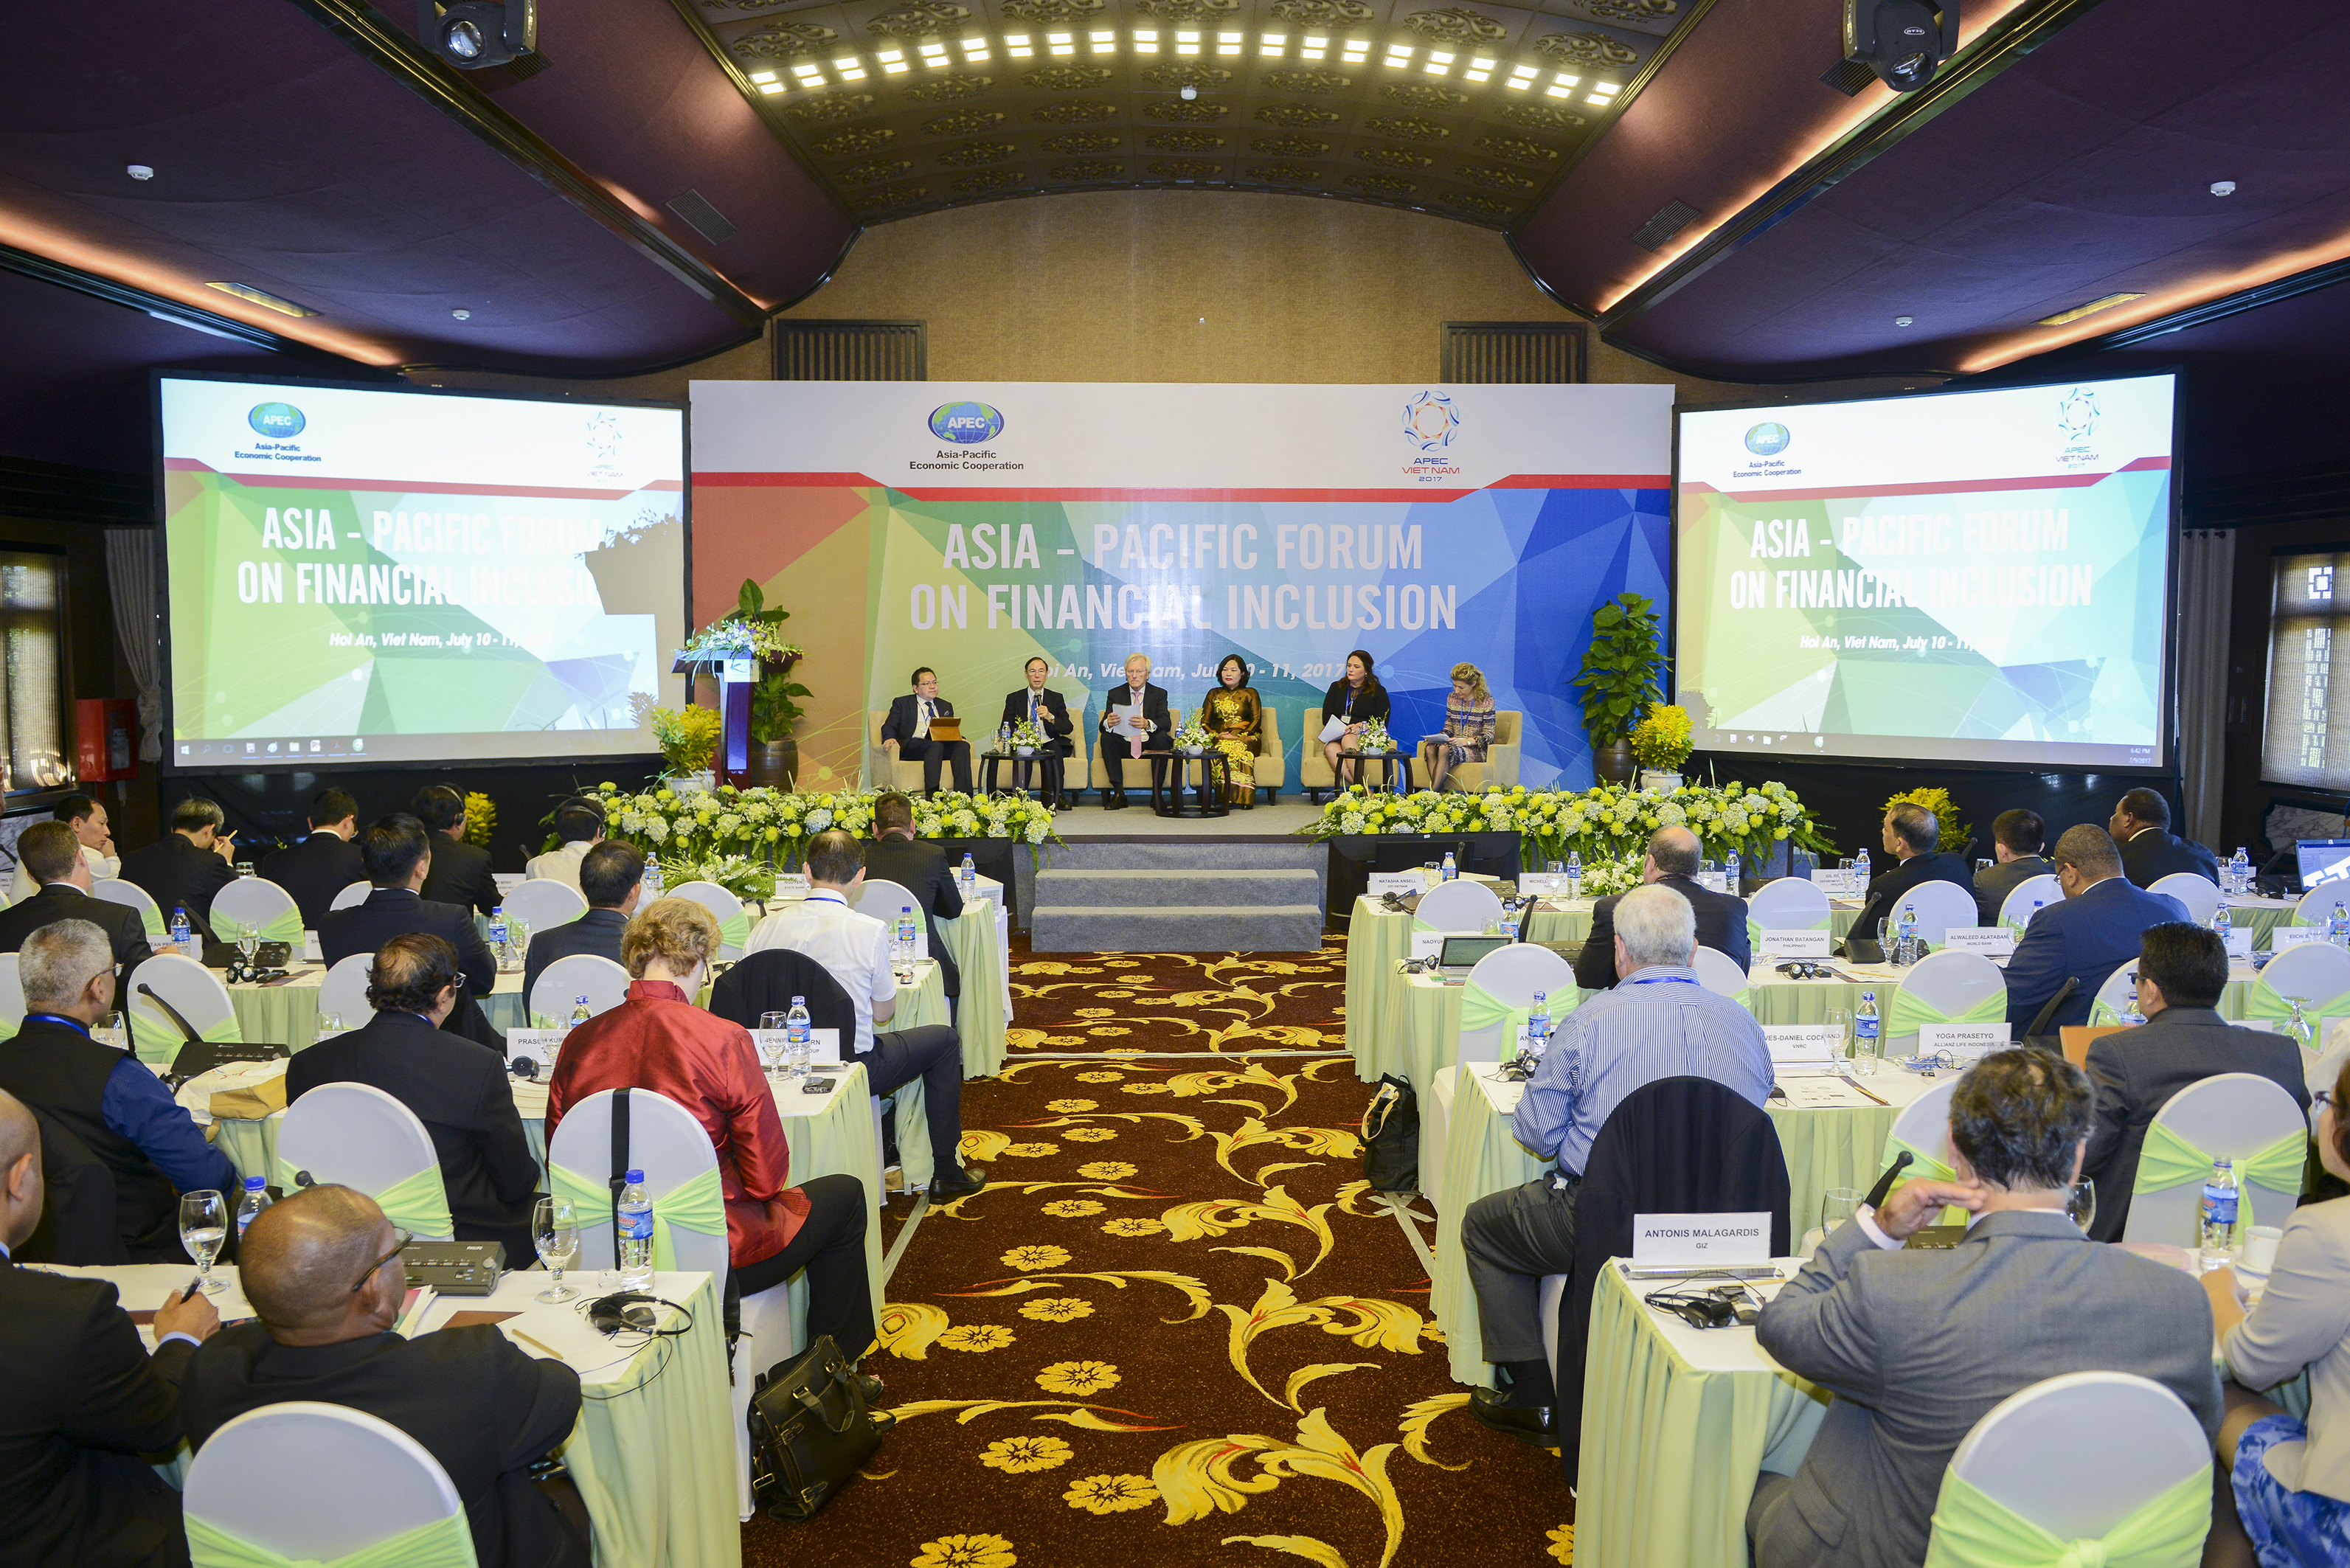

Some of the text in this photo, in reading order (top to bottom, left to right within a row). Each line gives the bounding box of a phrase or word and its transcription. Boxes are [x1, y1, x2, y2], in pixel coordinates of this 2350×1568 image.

[263, 415, 291, 426] APEC
[947, 417, 985, 429] APEC
[1756, 434, 1779, 444] APEC
[255, 443, 301, 452] Asia-Pacific
[936, 451, 997, 459] Asia-Pacific
[235, 451, 322, 462] Economic Cooperation
[909, 461, 1024, 471] Economic Cooperation
[262, 507, 336, 549] ASIA
[373, 510, 491, 554] PACIFIC
[502, 515, 600, 556] FORUM
[1750, 518, 1811, 558] ASIA
[1843, 513, 1951, 556] PACIFIC
[1963, 508, 2069, 553] FORUM
[943, 523, 1041, 569] ASIA
[1094, 523, 1258, 569] PACIFIC
[1277, 523, 1422, 569] FORUM
[238, 561, 603, 608] ON FINANCIAL INCLUSIO
[1730, 564, 2092, 609] ON FINANCIAL INCLUSION
[910, 583, 1456, 630] ON FINANCIAL INCLUSION
[329, 633, 353, 646] Hoi
[355, 633, 377, 648] An,
[381, 633, 406, 646] Viet
[409, 633, 443, 648] Nam,
[446, 633, 473, 649] July
[476, 633, 491, 646] 10
[1800, 636, 1820, 648] Hoi
[1821, 636, 1840, 651] An,
[1844, 636, 1866, 648] Viet
[1868, 636, 1899, 651] Nam,
[1902, 636, 1929, 651] July
[1932, 636, 1947, 649] 10
[1047, 663, 1058, 677] oi
[1063, 663, 1092, 680] An,
[1101, 663, 1126, 678] Vie
[1151, 667, 1185, 680] am,
[1191, 663, 1218, 678] Jul
[1272, 663, 1296, 680] 11,
[1302, 663, 1347, 677] 2017
[1645, 1229, 1759, 1238] ANTONIS MALAGARDIS
